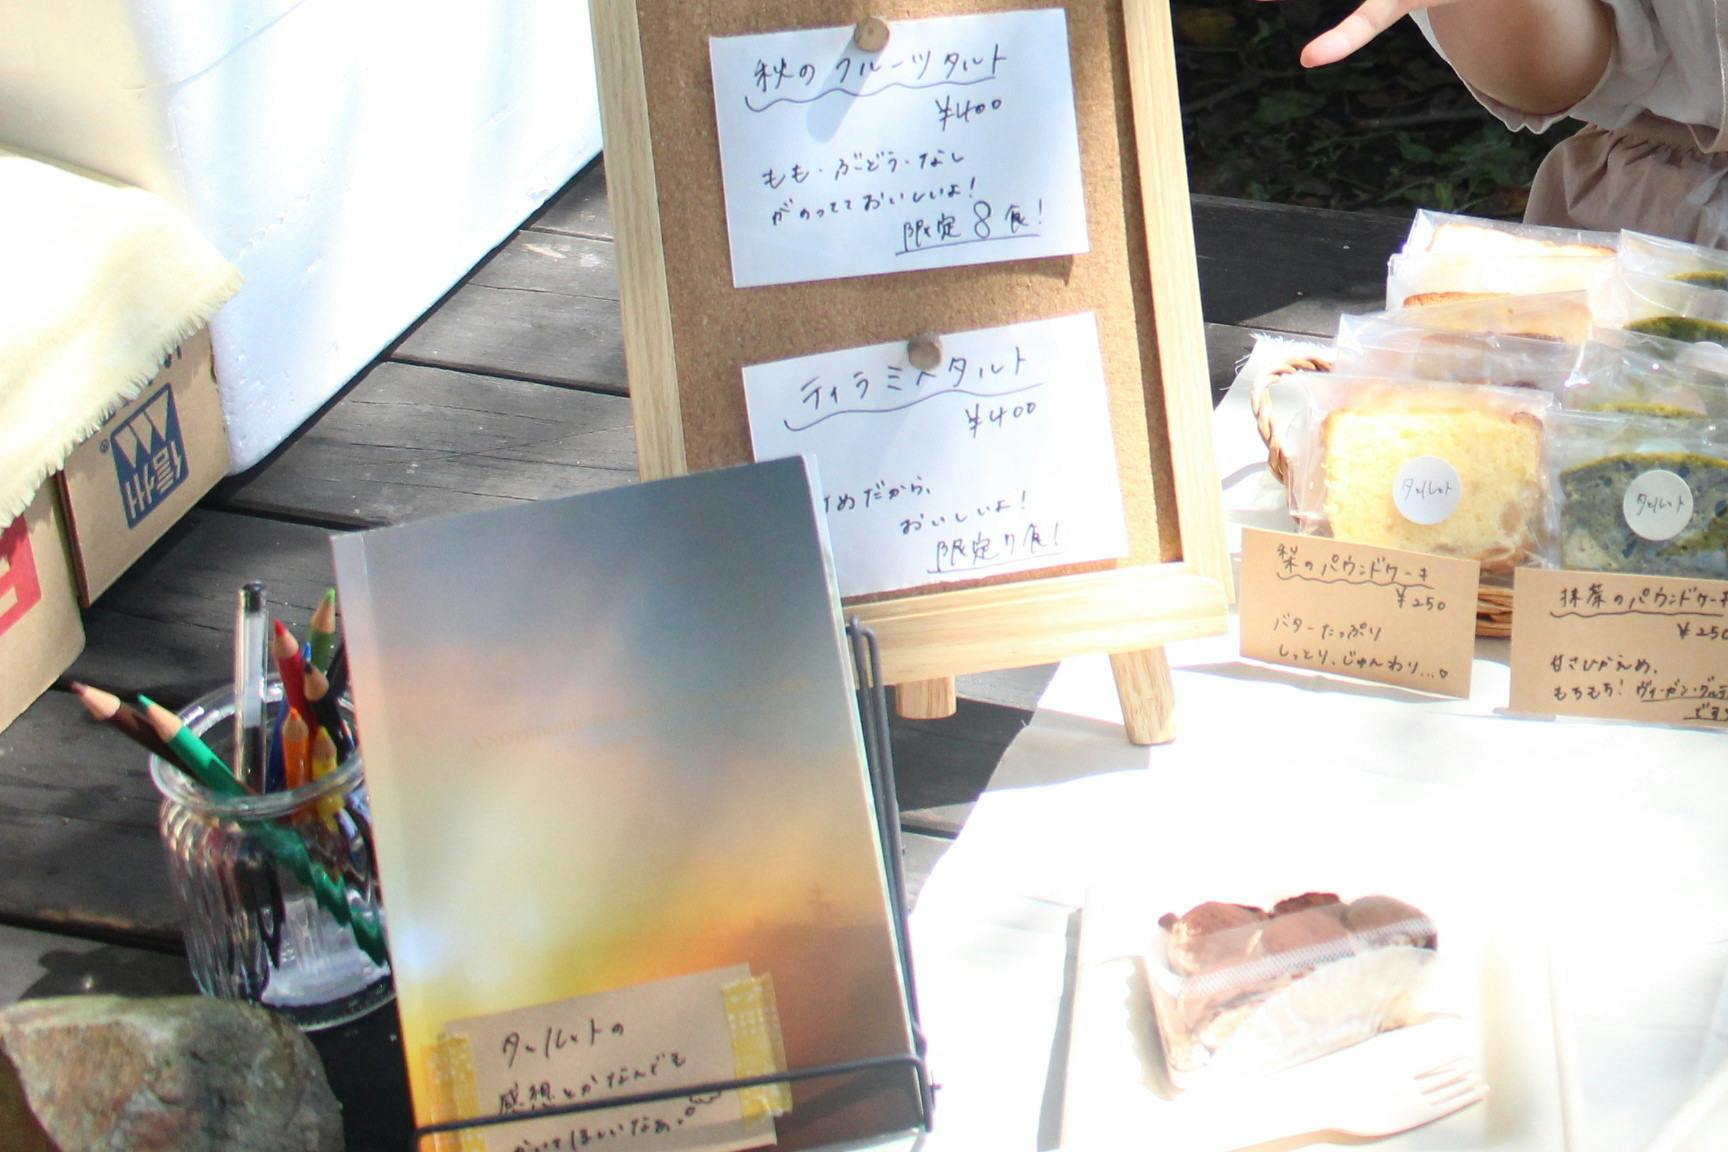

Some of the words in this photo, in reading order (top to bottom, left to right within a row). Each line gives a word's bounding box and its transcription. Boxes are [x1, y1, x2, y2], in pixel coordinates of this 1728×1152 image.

[753, 43, 1008, 93] 秋のフルーツタルト
[935, 95, 1003, 131] ¥400
[964, 401, 1037, 438] ¥400
[1276, 543, 1430, 582] 梨のパウンドケーキ
[1395, 585, 1447, 611] ¥250
[1273, 612, 1383, 641] バターたっぷり
